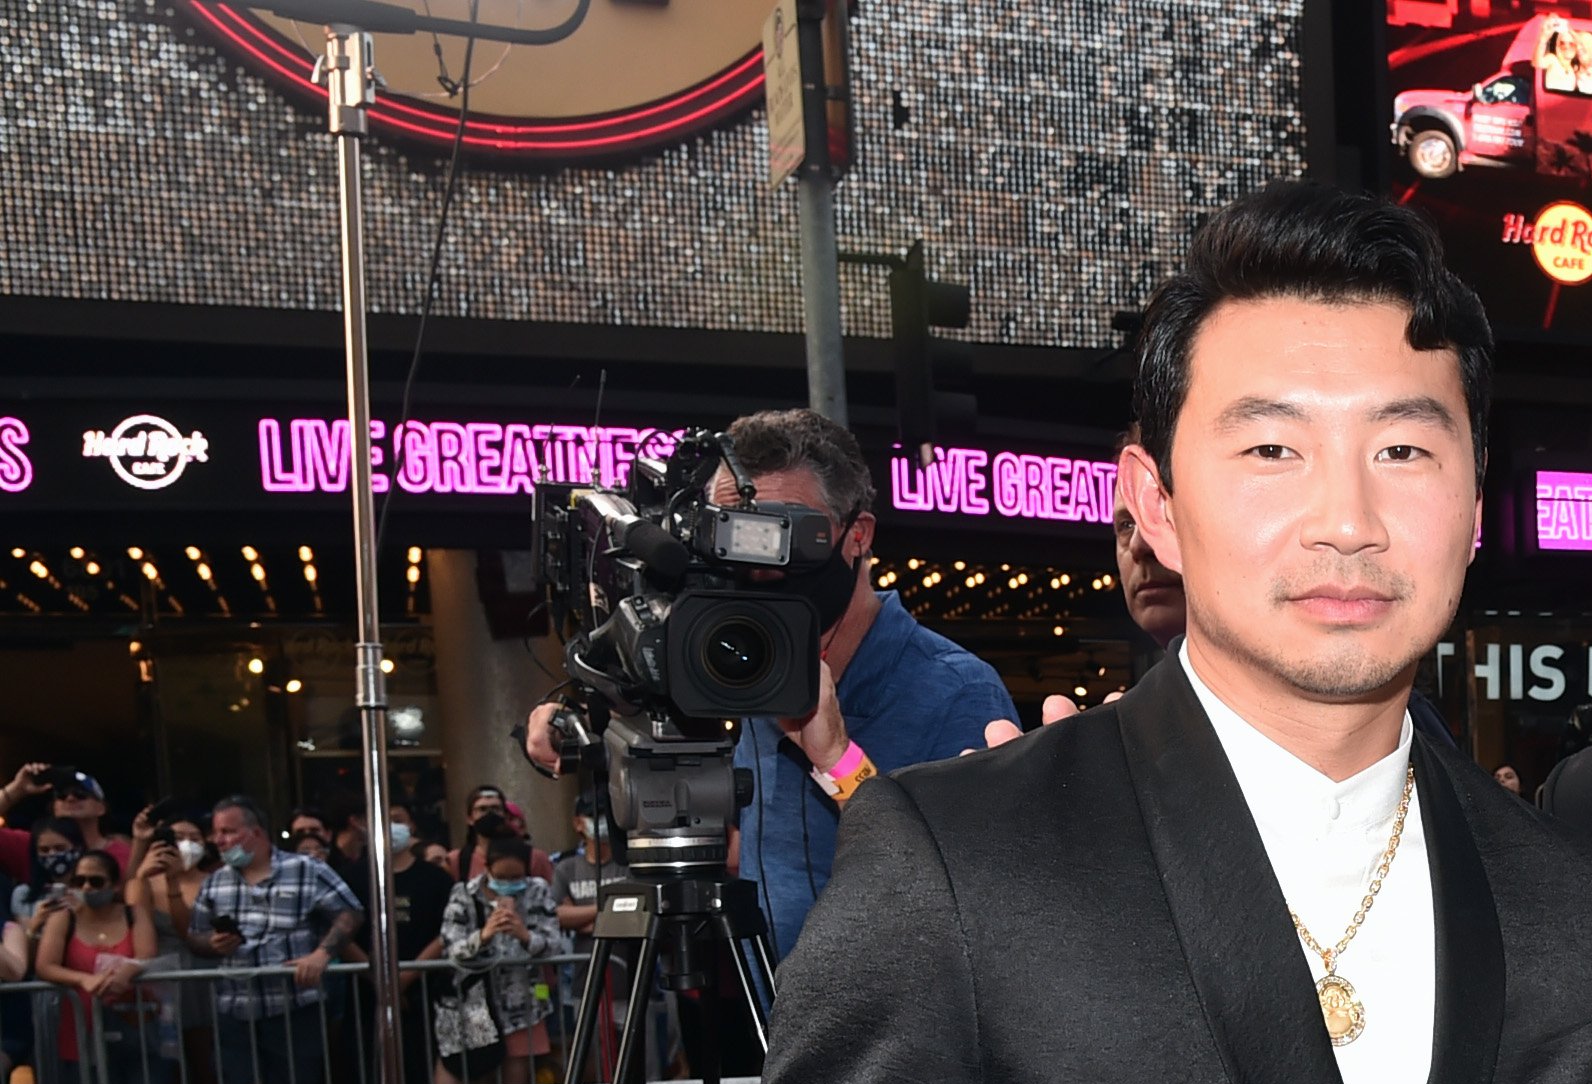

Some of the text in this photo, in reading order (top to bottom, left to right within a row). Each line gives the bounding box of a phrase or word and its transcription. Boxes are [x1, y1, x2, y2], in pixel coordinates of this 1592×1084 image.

[1502, 213, 1566, 244] Hard
[1553, 256, 1585, 270] CAFE
[258, 418, 389, 492] LIVE
[891, 443, 990, 515] LIVE
